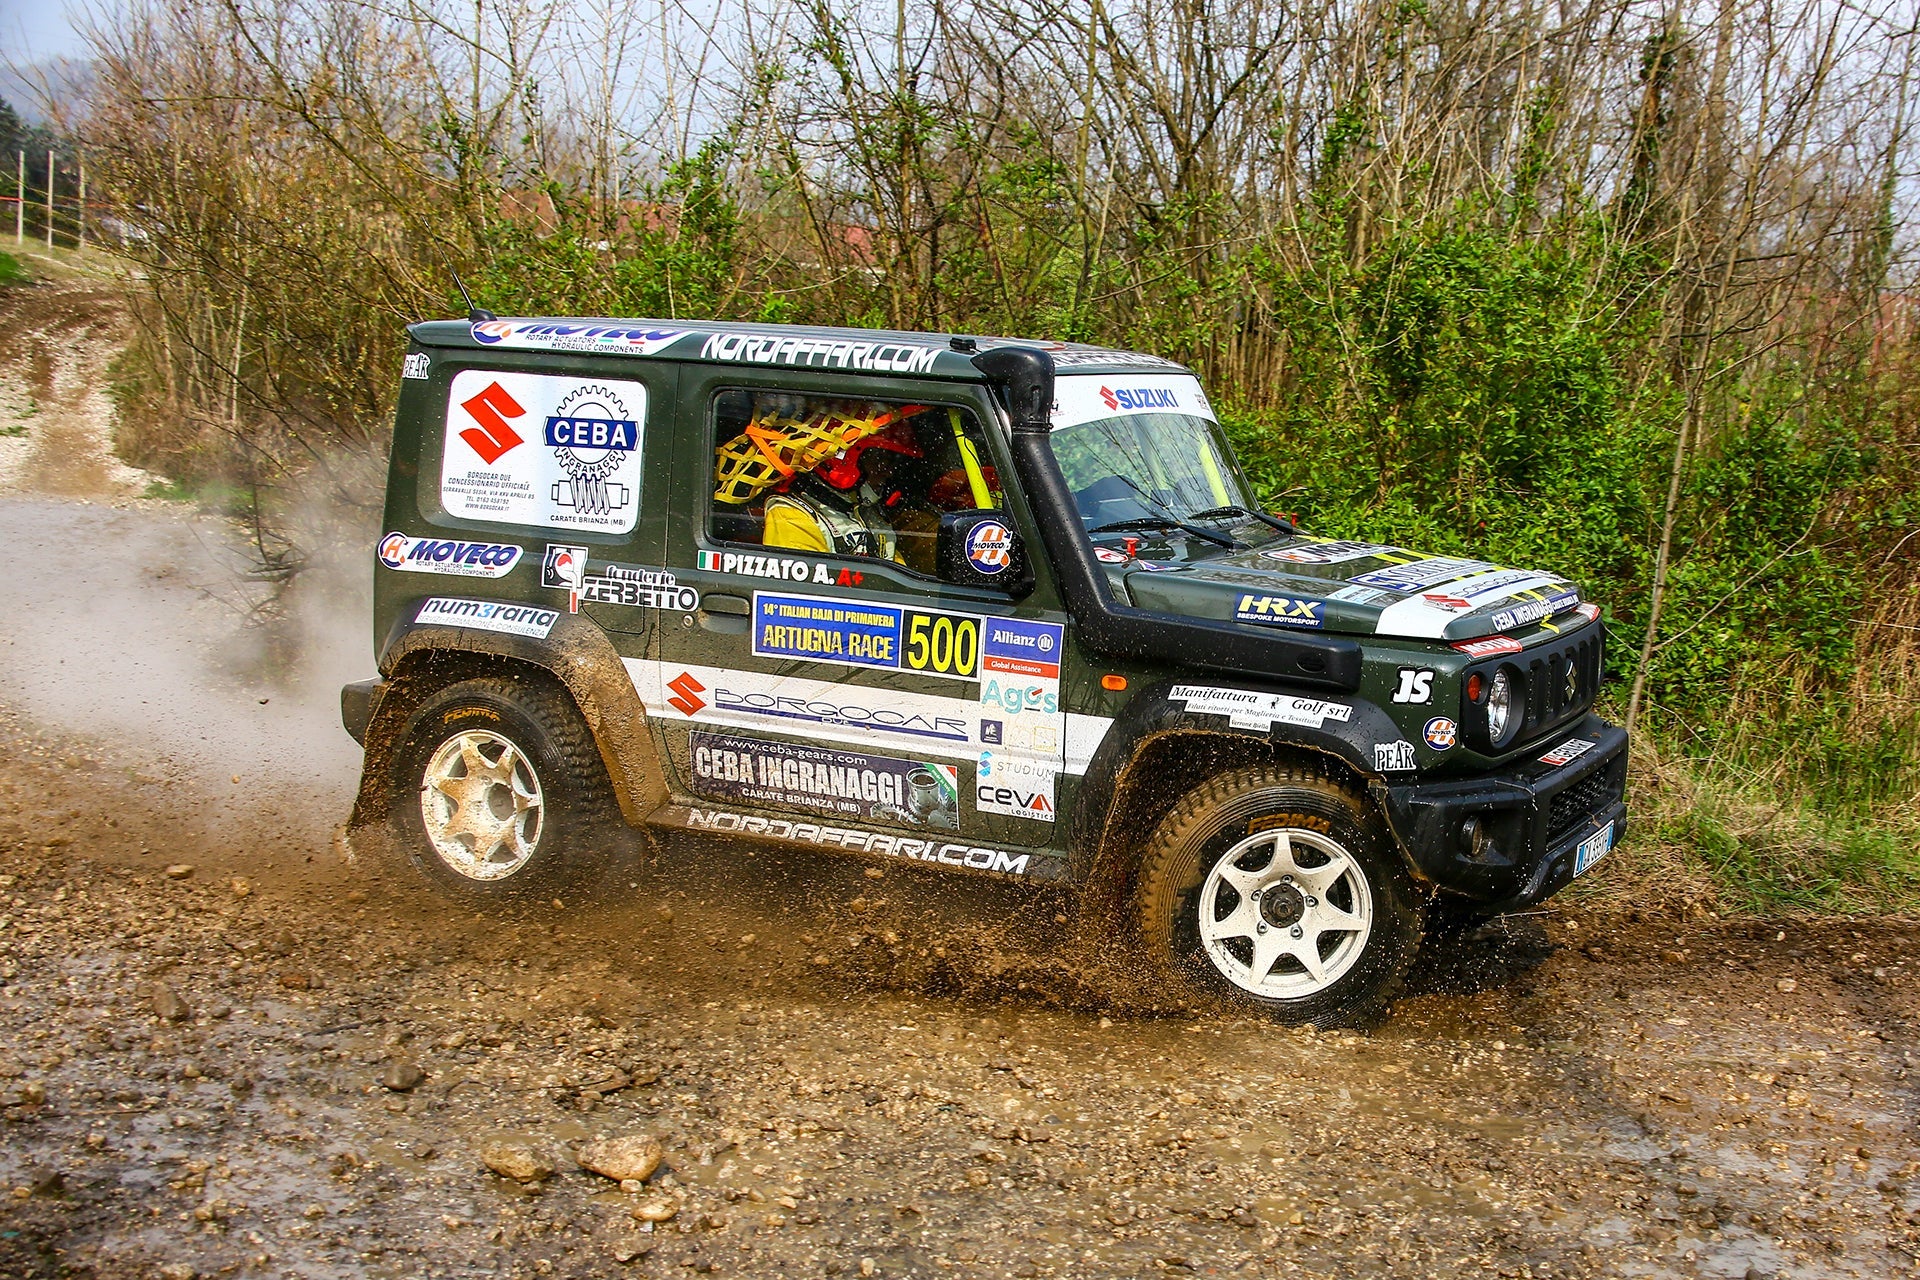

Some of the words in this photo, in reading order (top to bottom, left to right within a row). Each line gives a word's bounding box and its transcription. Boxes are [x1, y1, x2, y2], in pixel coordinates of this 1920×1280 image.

[525, 334, 552, 342] ROTARY
[554, 336, 597, 344] ACTUATORS
[551, 342, 593, 351] HYDRAULIC
[593, 344, 644, 353] COMPONENTS
[701, 333, 944, 374] NORDAFFARI.COM
[1115, 388, 1179, 410] SUZUKI
[553, 419, 628, 448] CEBA
[560, 447, 620, 473] INGRANAGGI
[448, 477, 500, 488] CONCESSIONARIO
[501, 481, 530, 491] UFFICIALE
[550, 514, 577, 523] CARATE
[578, 516, 609, 525] BRIANZA
[610, 518, 626, 527] (MB)
[407, 540, 518, 567] MOVECO
[973, 542, 1005, 550] MOVECO
[722, 553, 809, 582] PIZZATO
[812, 563, 836, 586] A.
[837, 567, 864, 588] A+
[583, 578, 697, 610] ZERBETTO
[1238, 594, 1322, 618] HRX
[423, 599, 557, 628] num3raria
[779, 604, 811, 619] ITALIAN
[811, 607, 834, 622] BAJA
[834, 609, 844, 623] DI
[845, 611, 895, 628] PRIMAVERA
[1272, 615, 1321, 626] MOTORSPORT
[1491, 611, 1518, 632] CEBA
[1512, 598, 1555, 624] INGRANAGGI
[495, 622, 546, 637] CONSULENZA
[762, 624, 843, 655] ARTUGNA
[848, 632, 894, 661] RACE
[992, 629, 1036, 647] Allianz
[907, 614, 977, 676] 500
[990, 660, 1008, 671] Global
[1009, 662, 1042, 674] Assistance
[1393, 670, 1434, 703] JS
[714, 688, 967, 734] BORGOCAR
[1171, 686, 1258, 703] Manifattura
[1291, 699, 1328, 715] Golf
[1327, 707, 1350, 718] srl
[1207, 705, 1230, 713] ritorti
[1244, 708, 1280, 719] Maglieria
[1287, 714, 1321, 726] Tessitura
[723, 739, 868, 767] www.ceba-gears.com
[1376, 741, 1414, 770] PEAK
[695, 746, 756, 785] CEBA
[758, 755, 903, 806] INGRANAGGI
[996, 761, 1055, 779] STUDIUM
[741, 787, 785, 802] CARATE
[786, 793, 835, 809] BRIANZA
[836, 801, 861, 815] (MB)
[1011, 808, 1054, 821] LOGISTICS
[685, 807, 1030, 875] NORDAFFARI.COM
